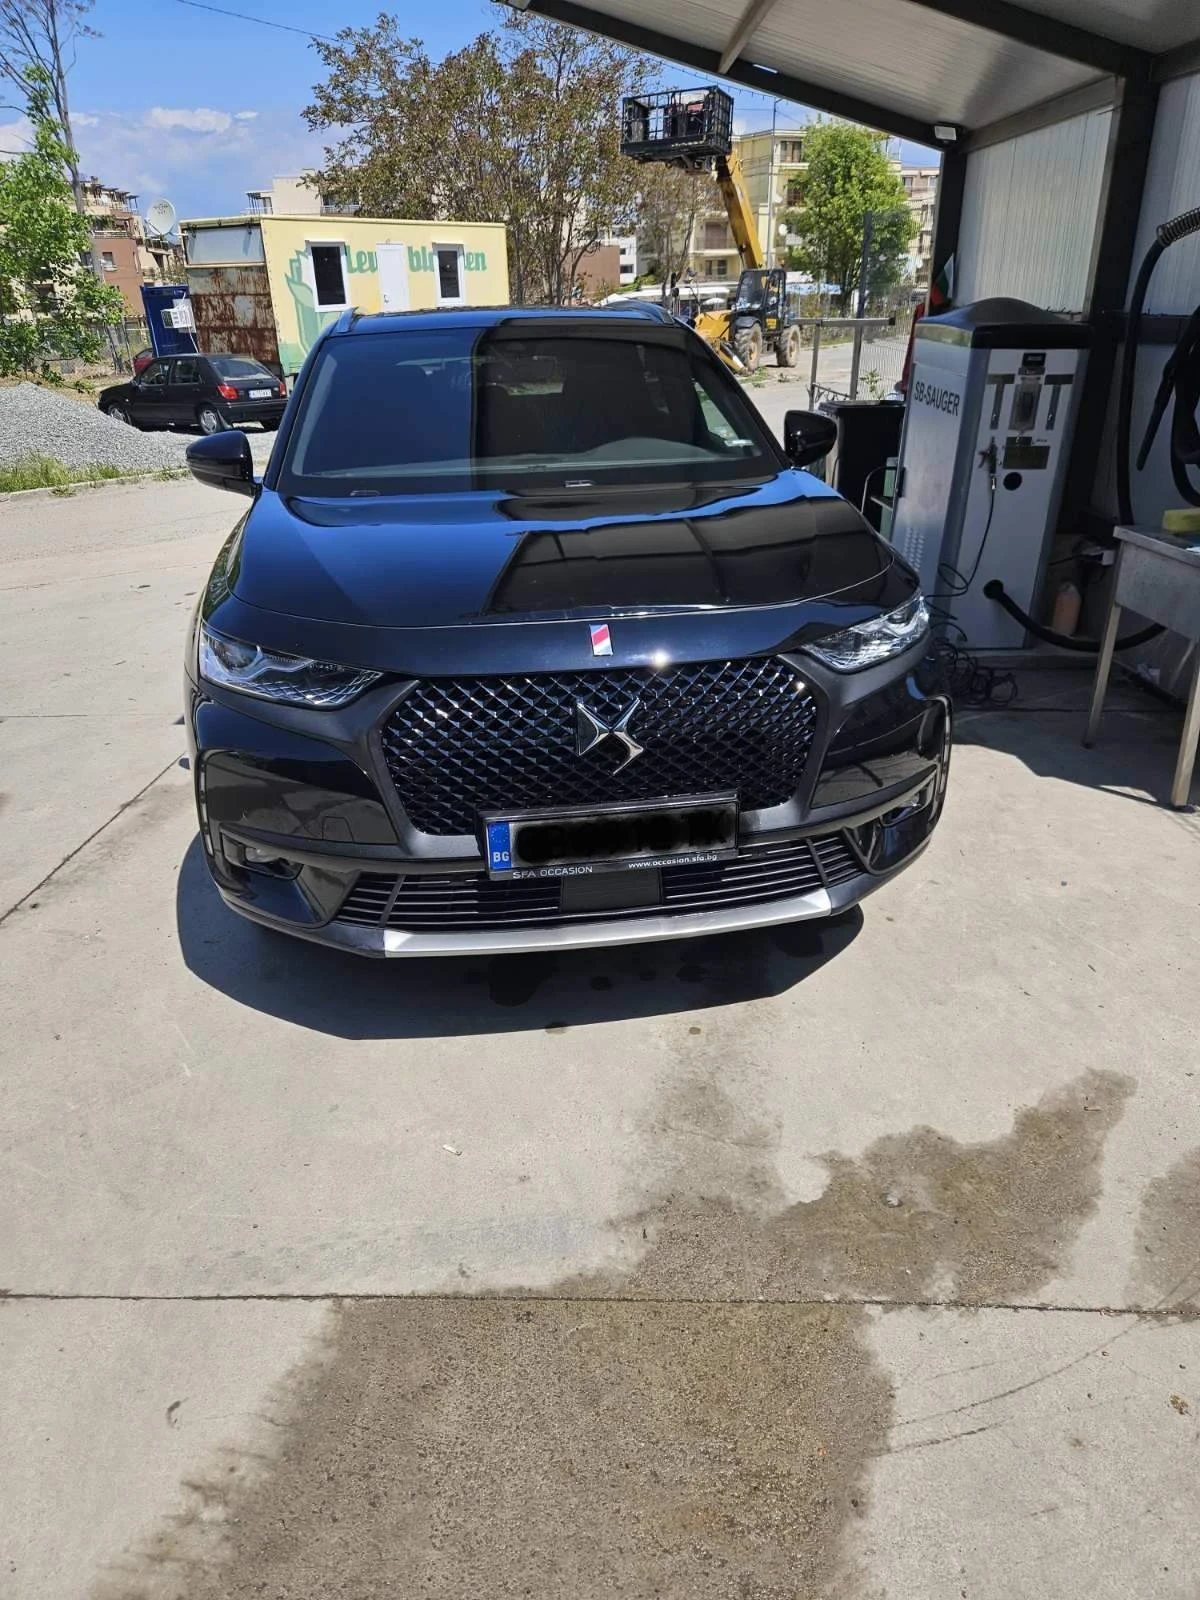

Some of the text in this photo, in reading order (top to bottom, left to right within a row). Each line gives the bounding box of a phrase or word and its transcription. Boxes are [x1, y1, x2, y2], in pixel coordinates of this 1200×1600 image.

[914, 381, 960, 416] SB-SAUGER
[493, 851, 510, 862] BG
[628, 854, 718, 869] www.occasion.sfa.bg
[513, 866, 593, 879] SFA OCCASION
